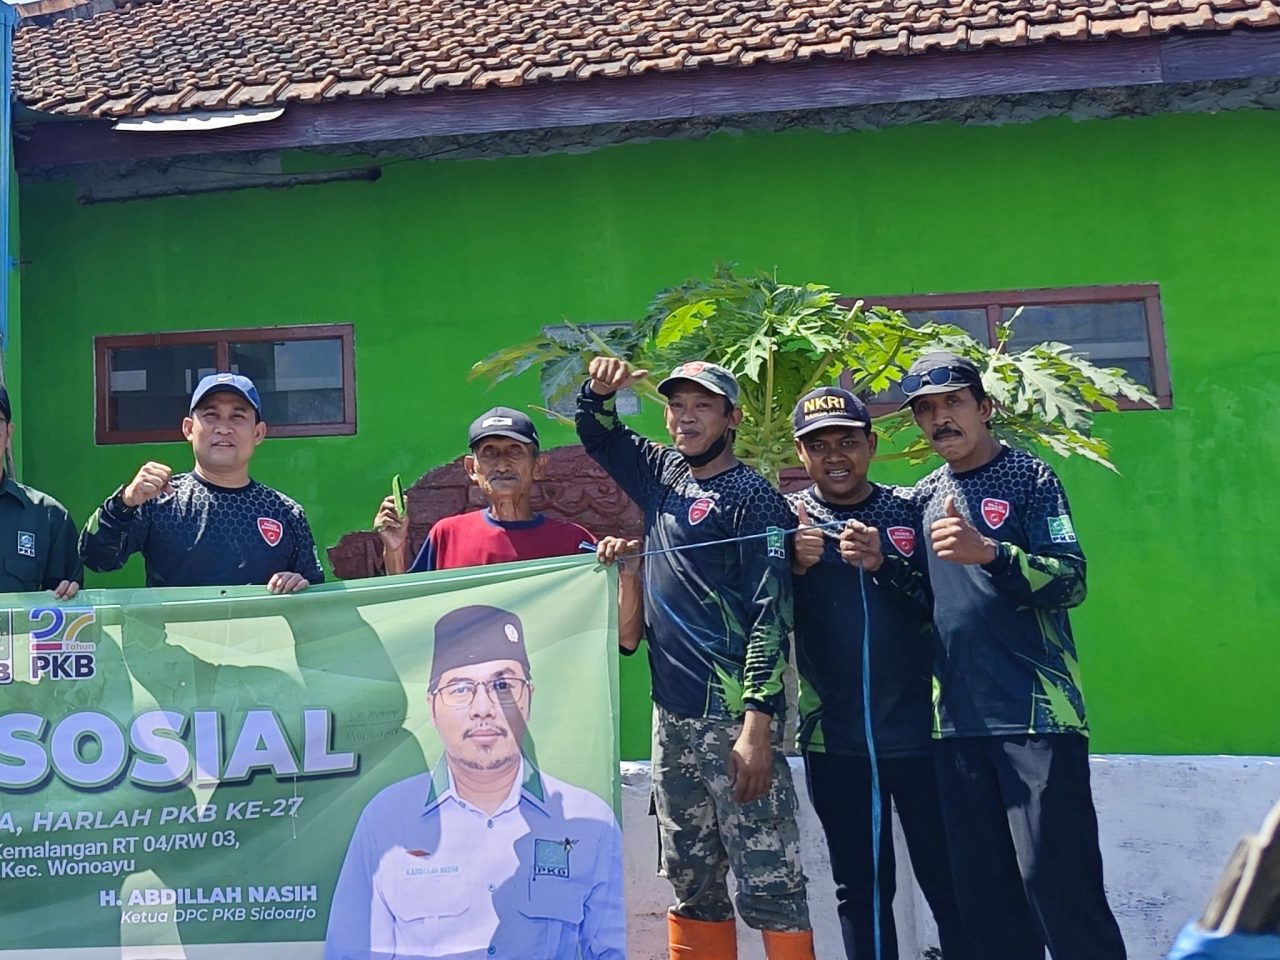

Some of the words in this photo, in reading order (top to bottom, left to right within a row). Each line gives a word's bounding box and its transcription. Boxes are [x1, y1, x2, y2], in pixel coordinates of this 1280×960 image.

[803, 395, 845, 413] NKRI
[64, 642, 95, 651] Tahun
[30, 654, 96, 679] PKB
[31, 808, 151, 833] HARLAH
[160, 803, 218, 826] PKB
[224, 796, 304, 821] KE-27
[112, 837, 135, 854] RT
[143, 833, 207, 853] 04/RW
[211, 830, 240, 849] 03,
[47, 858, 136, 877] Wonoayu
[99, 889, 122, 907] H.
[127, 887, 242, 907] ABDILLAH
[248, 885, 318, 903] NASIH
[120, 908, 168, 924] Ketua
[173, 908, 208, 922] DPC
[212, 907, 246, 922] PKB
[250, 905, 317, 922] Sidoarjo
